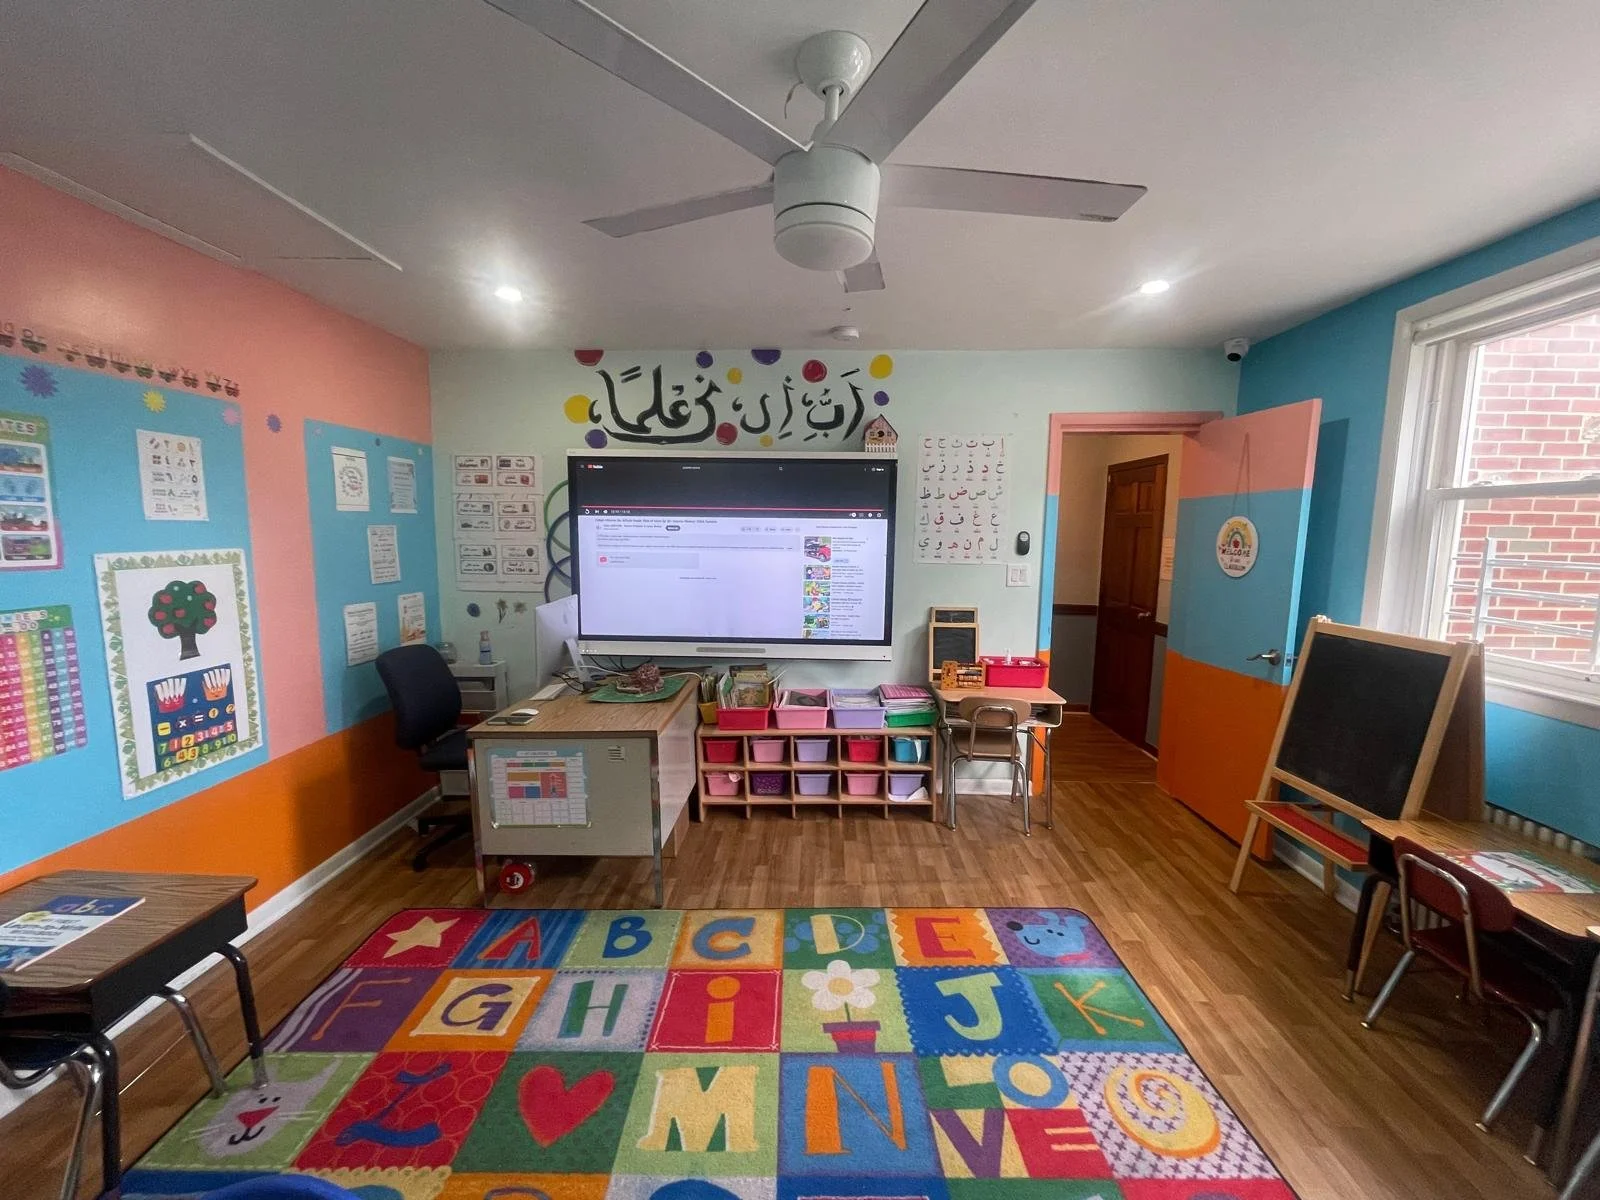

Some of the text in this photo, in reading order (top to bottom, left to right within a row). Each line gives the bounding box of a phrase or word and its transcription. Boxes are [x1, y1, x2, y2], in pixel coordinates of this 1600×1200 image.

[476, 916, 542, 960] A
[601, 916, 653, 958] B
[691, 917, 758, 959] C
[809, 912, 866, 955] D
[914, 917, 977, 959] E
[311, 977, 411, 1041] F
[440, 983, 513, 1031] G
[557, 979, 630, 1039] H
[934, 971, 1003, 1042] J
[1053, 980, 1146, 1036] K
[637, 1065, 758, 1153] M
[804, 1061, 908, 1155] N
